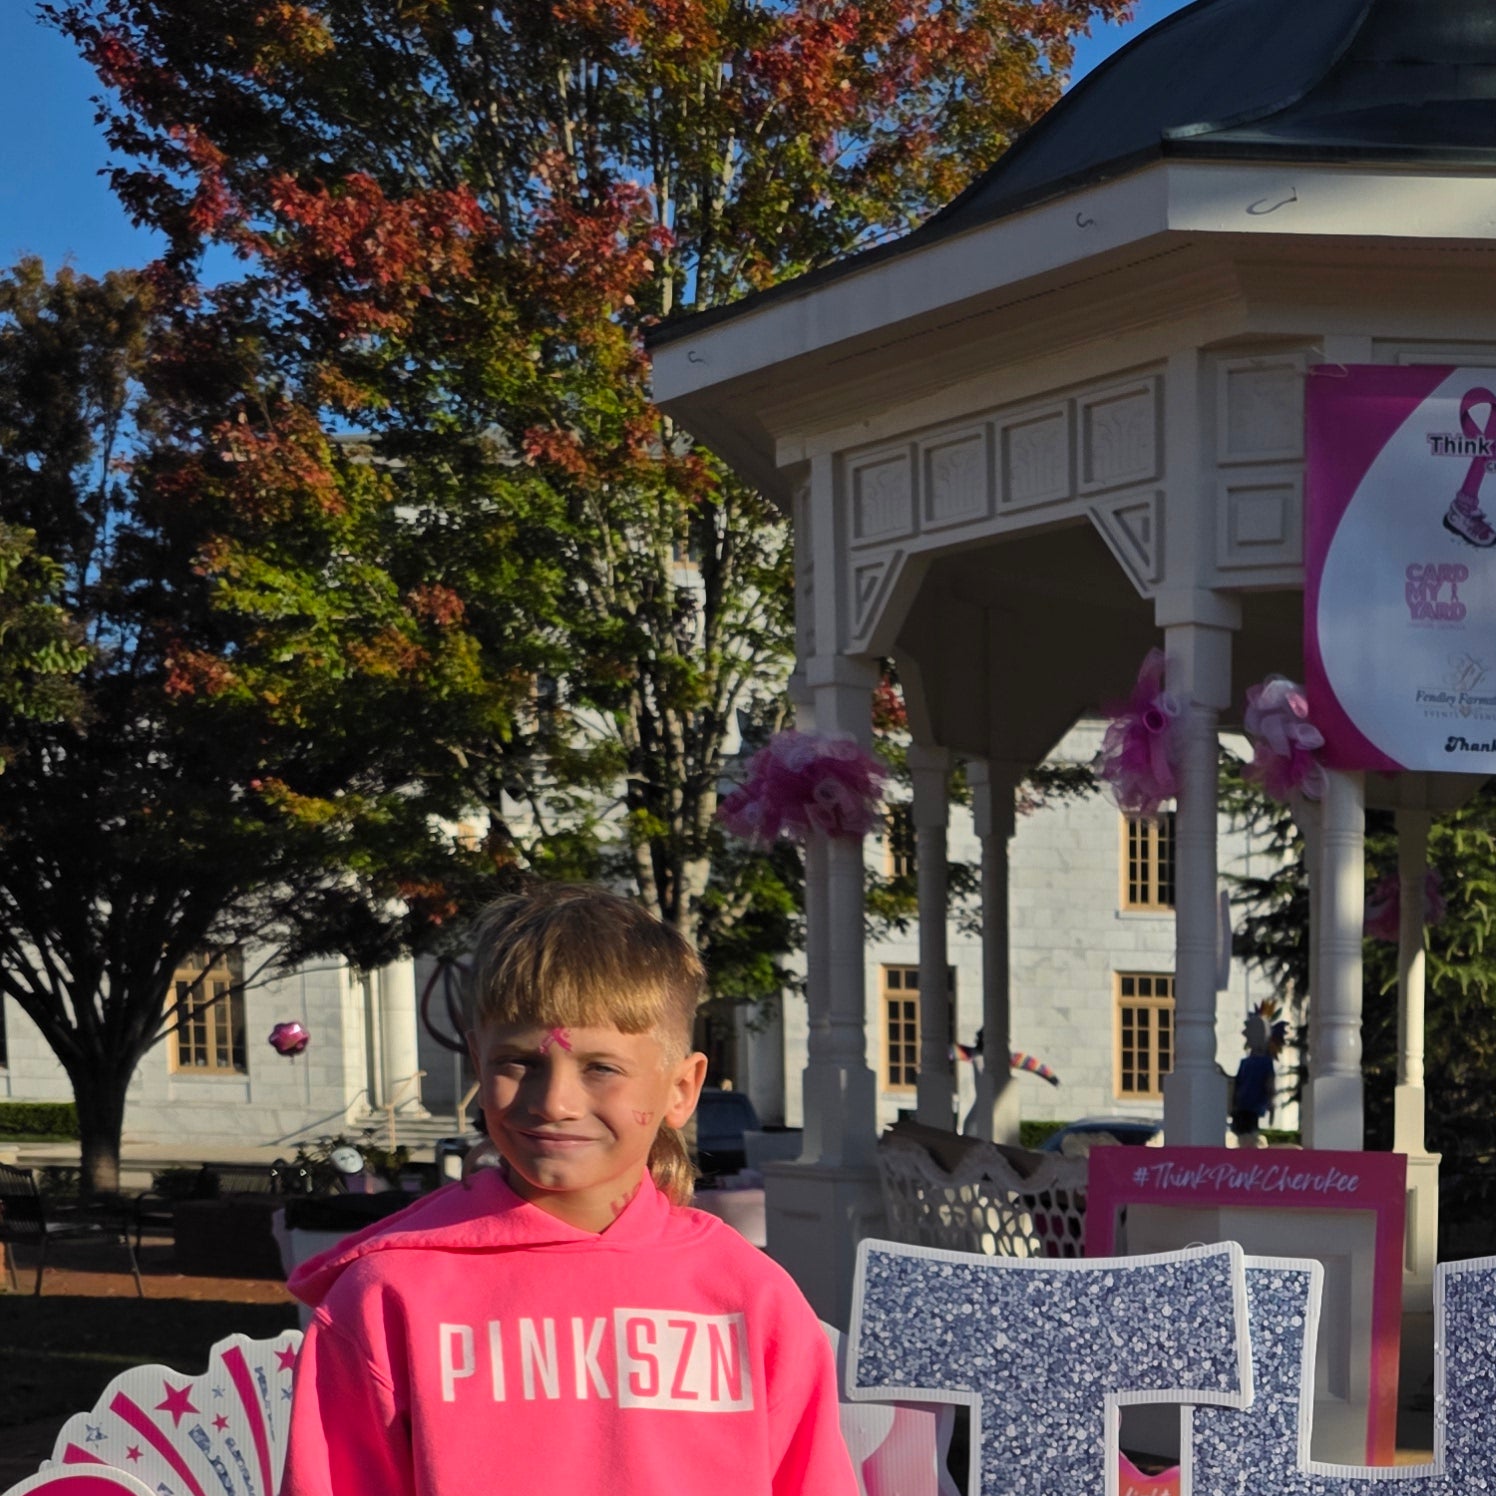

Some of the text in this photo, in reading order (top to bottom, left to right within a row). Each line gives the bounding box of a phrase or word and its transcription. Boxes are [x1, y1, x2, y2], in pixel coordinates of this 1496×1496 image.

[1430, 436, 1491, 455] Think
[1405, 562, 1469, 583] CARD
[1405, 581, 1442, 604] MY
[1407, 601, 1468, 623] YARD
[1132, 1162, 1360, 1193] #ThinkPinkCherokee
